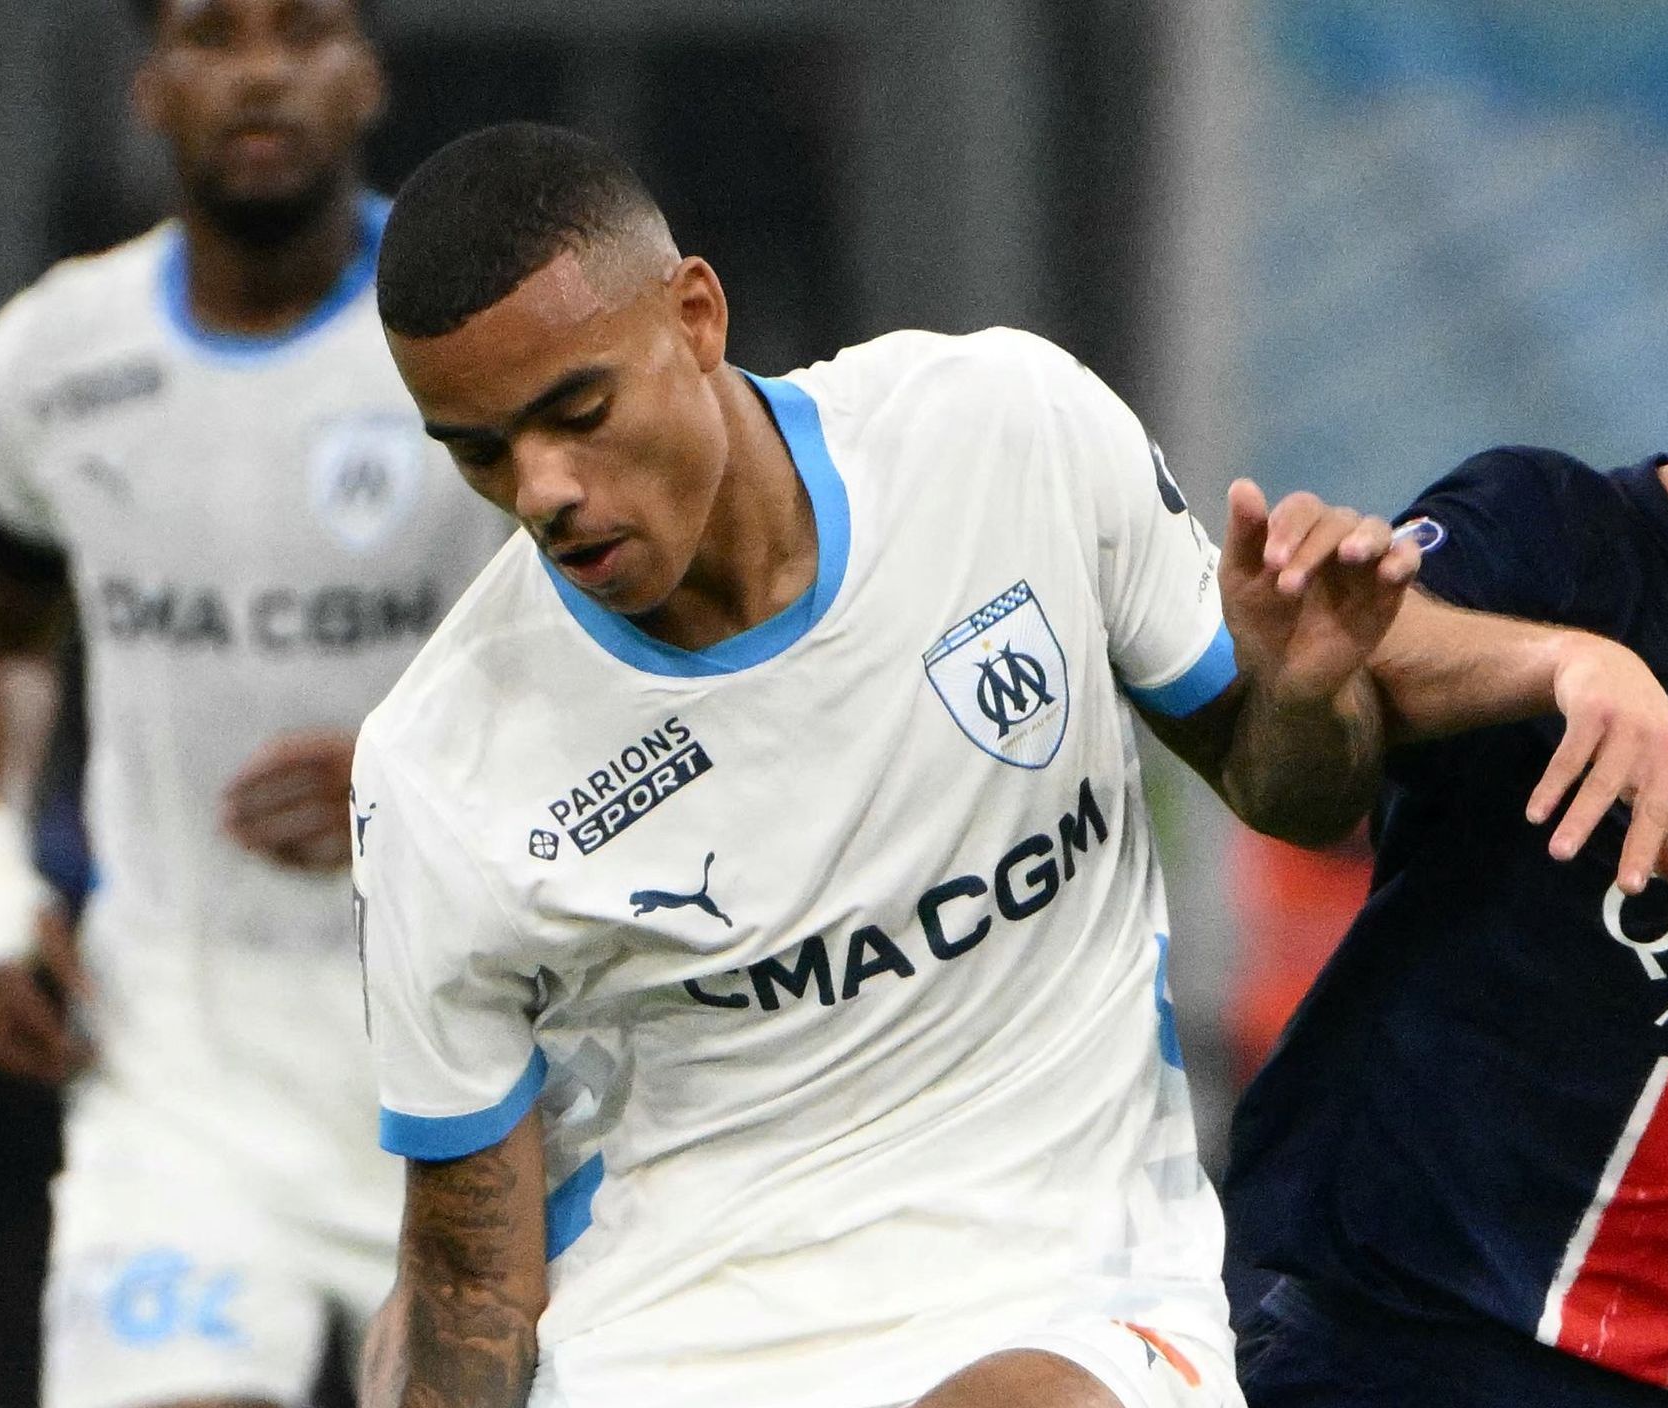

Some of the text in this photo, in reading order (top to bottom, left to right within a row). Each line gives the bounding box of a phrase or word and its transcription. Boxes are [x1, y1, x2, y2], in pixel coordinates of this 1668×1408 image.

[547, 714, 692, 827] PARIONS
[577, 747, 700, 851] SPORT
[916, 777, 1109, 961] CGM
